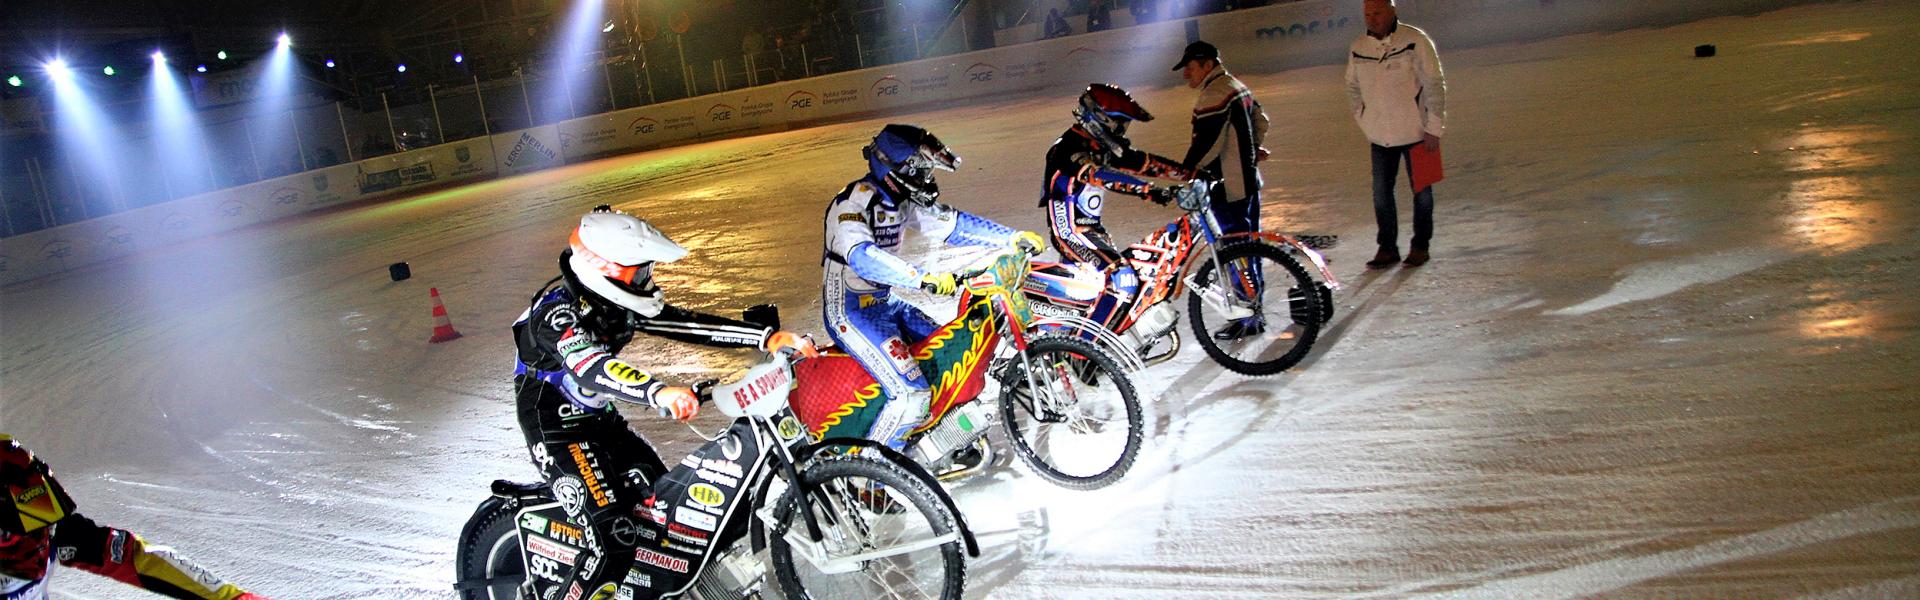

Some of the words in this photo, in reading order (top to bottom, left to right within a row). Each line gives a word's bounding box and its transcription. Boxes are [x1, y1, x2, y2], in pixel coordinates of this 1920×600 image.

[970, 71, 993, 83] PGE
[877, 85, 899, 97] PGE
[791, 98, 812, 110] PGE
[712, 110, 731, 122] PGE
[634, 124, 654, 136] PGE
[504, 138, 527, 167] LEROY
[521, 132, 556, 160] MERLIN
[609, 362, 646, 381] HN
[733, 387, 752, 410] BE
[748, 383, 760, 402] A
[692, 486, 720, 504] HN
[528, 541, 556, 558] Wilfried
[635, 548, 671, 569] GERMAN
[672, 559, 688, 573] OIL
